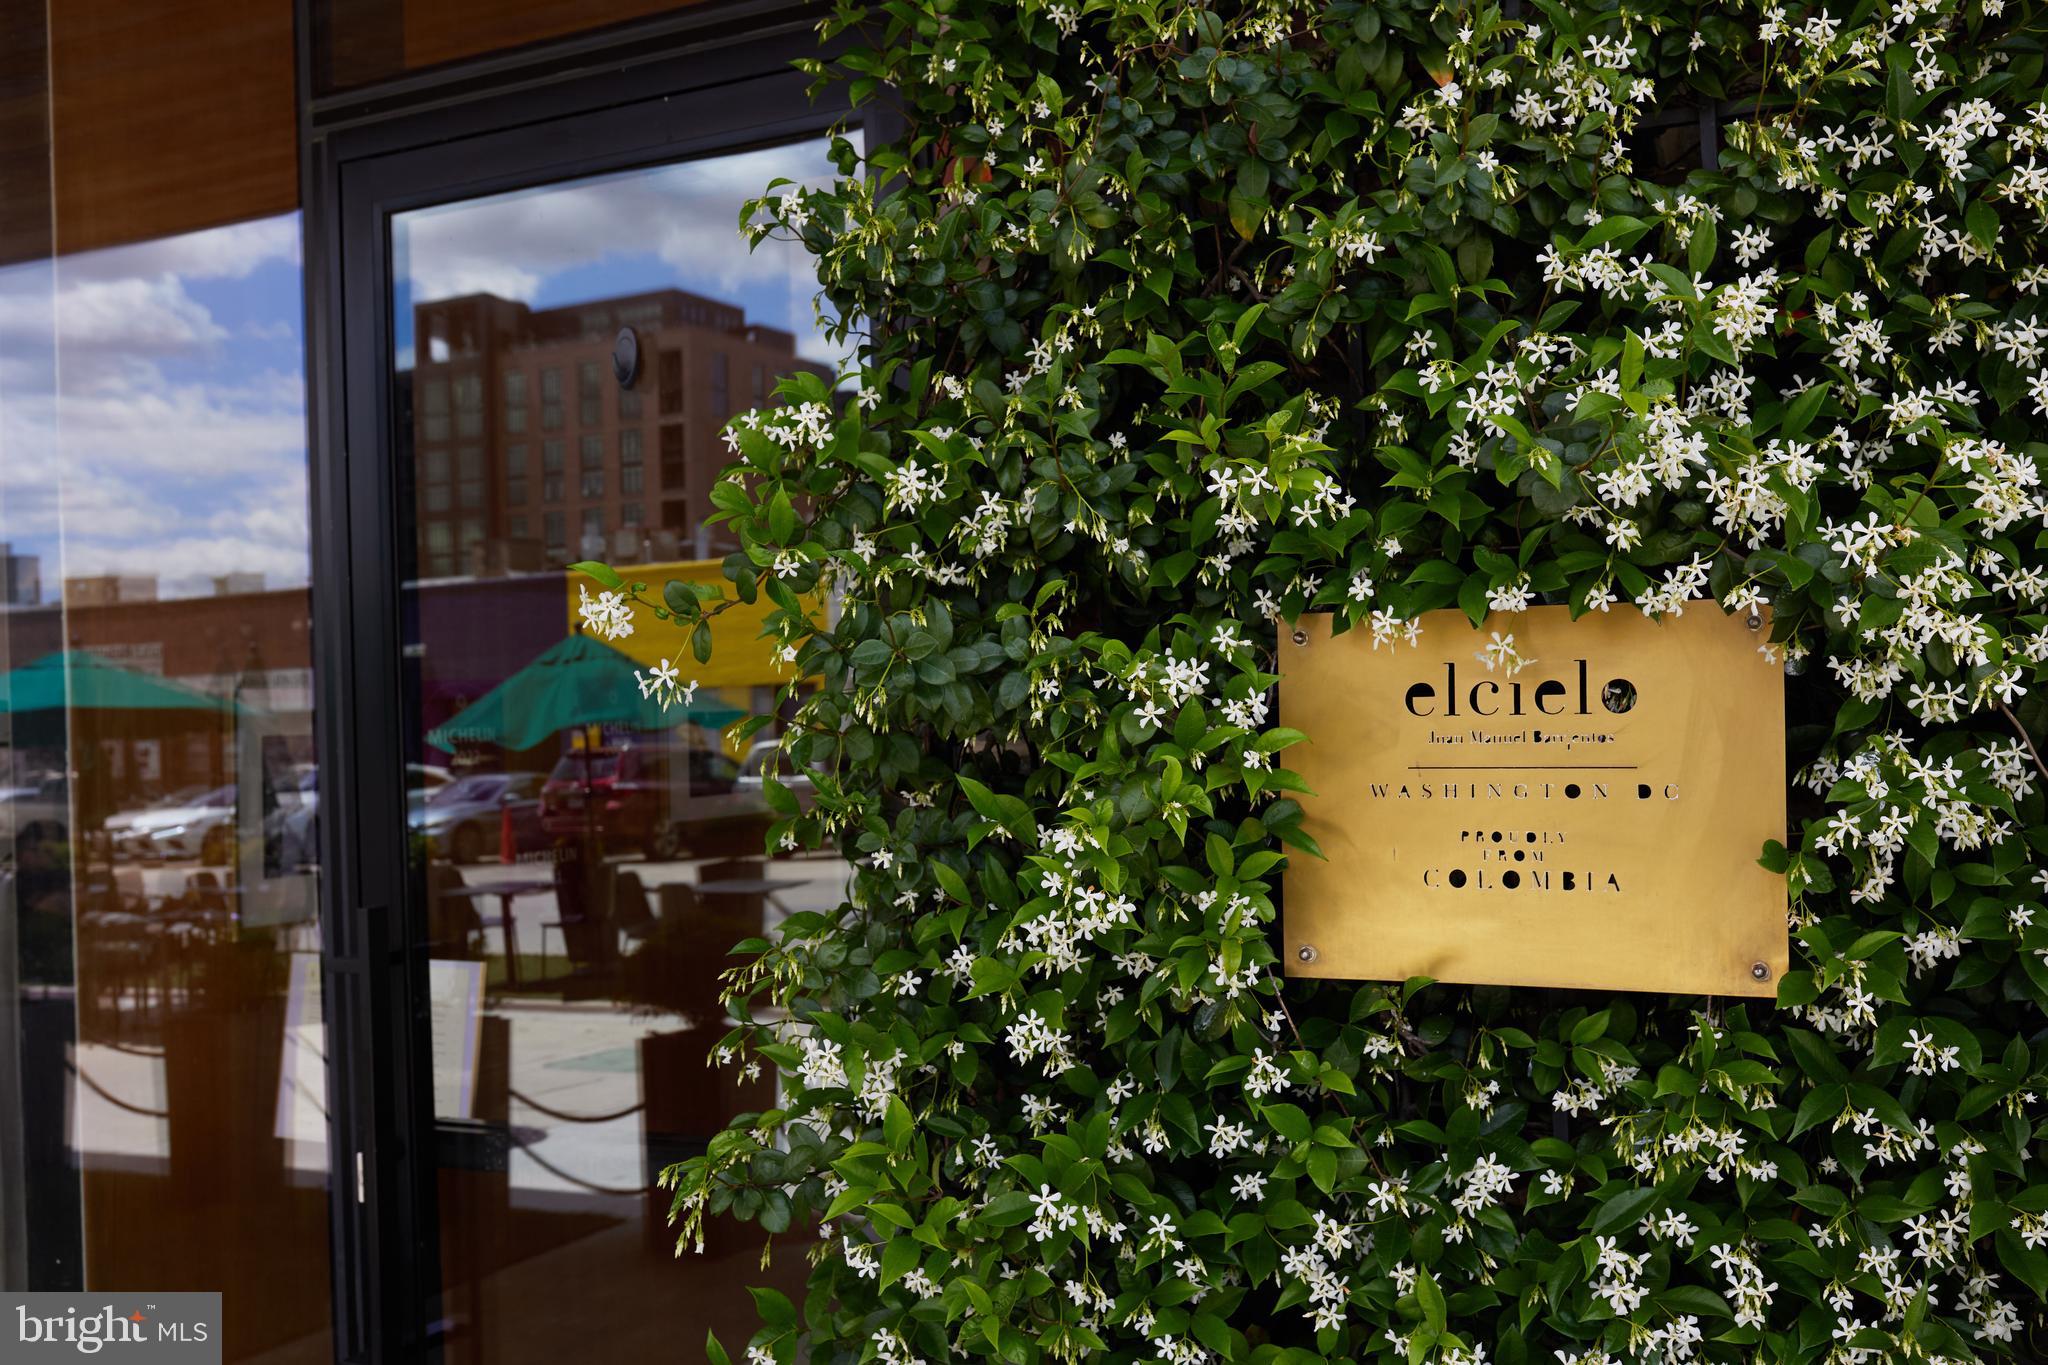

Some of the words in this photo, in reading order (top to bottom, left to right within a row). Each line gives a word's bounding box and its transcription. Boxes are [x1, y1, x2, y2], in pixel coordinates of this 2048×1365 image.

[1404, 659, 1638, 717] elcielo
[427, 727, 496, 745] MICHELIN
[1428, 730, 1464, 744] Juan
[1470, 730, 1527, 744] Manuel
[1369, 783, 1609, 800] WASHINGTON
[1636, 783, 1680, 800] DC
[1461, 830, 1568, 844] PROUDLY
[1483, 849, 1544, 862] FROM
[1423, 868, 1622, 892] COLOMBIA
